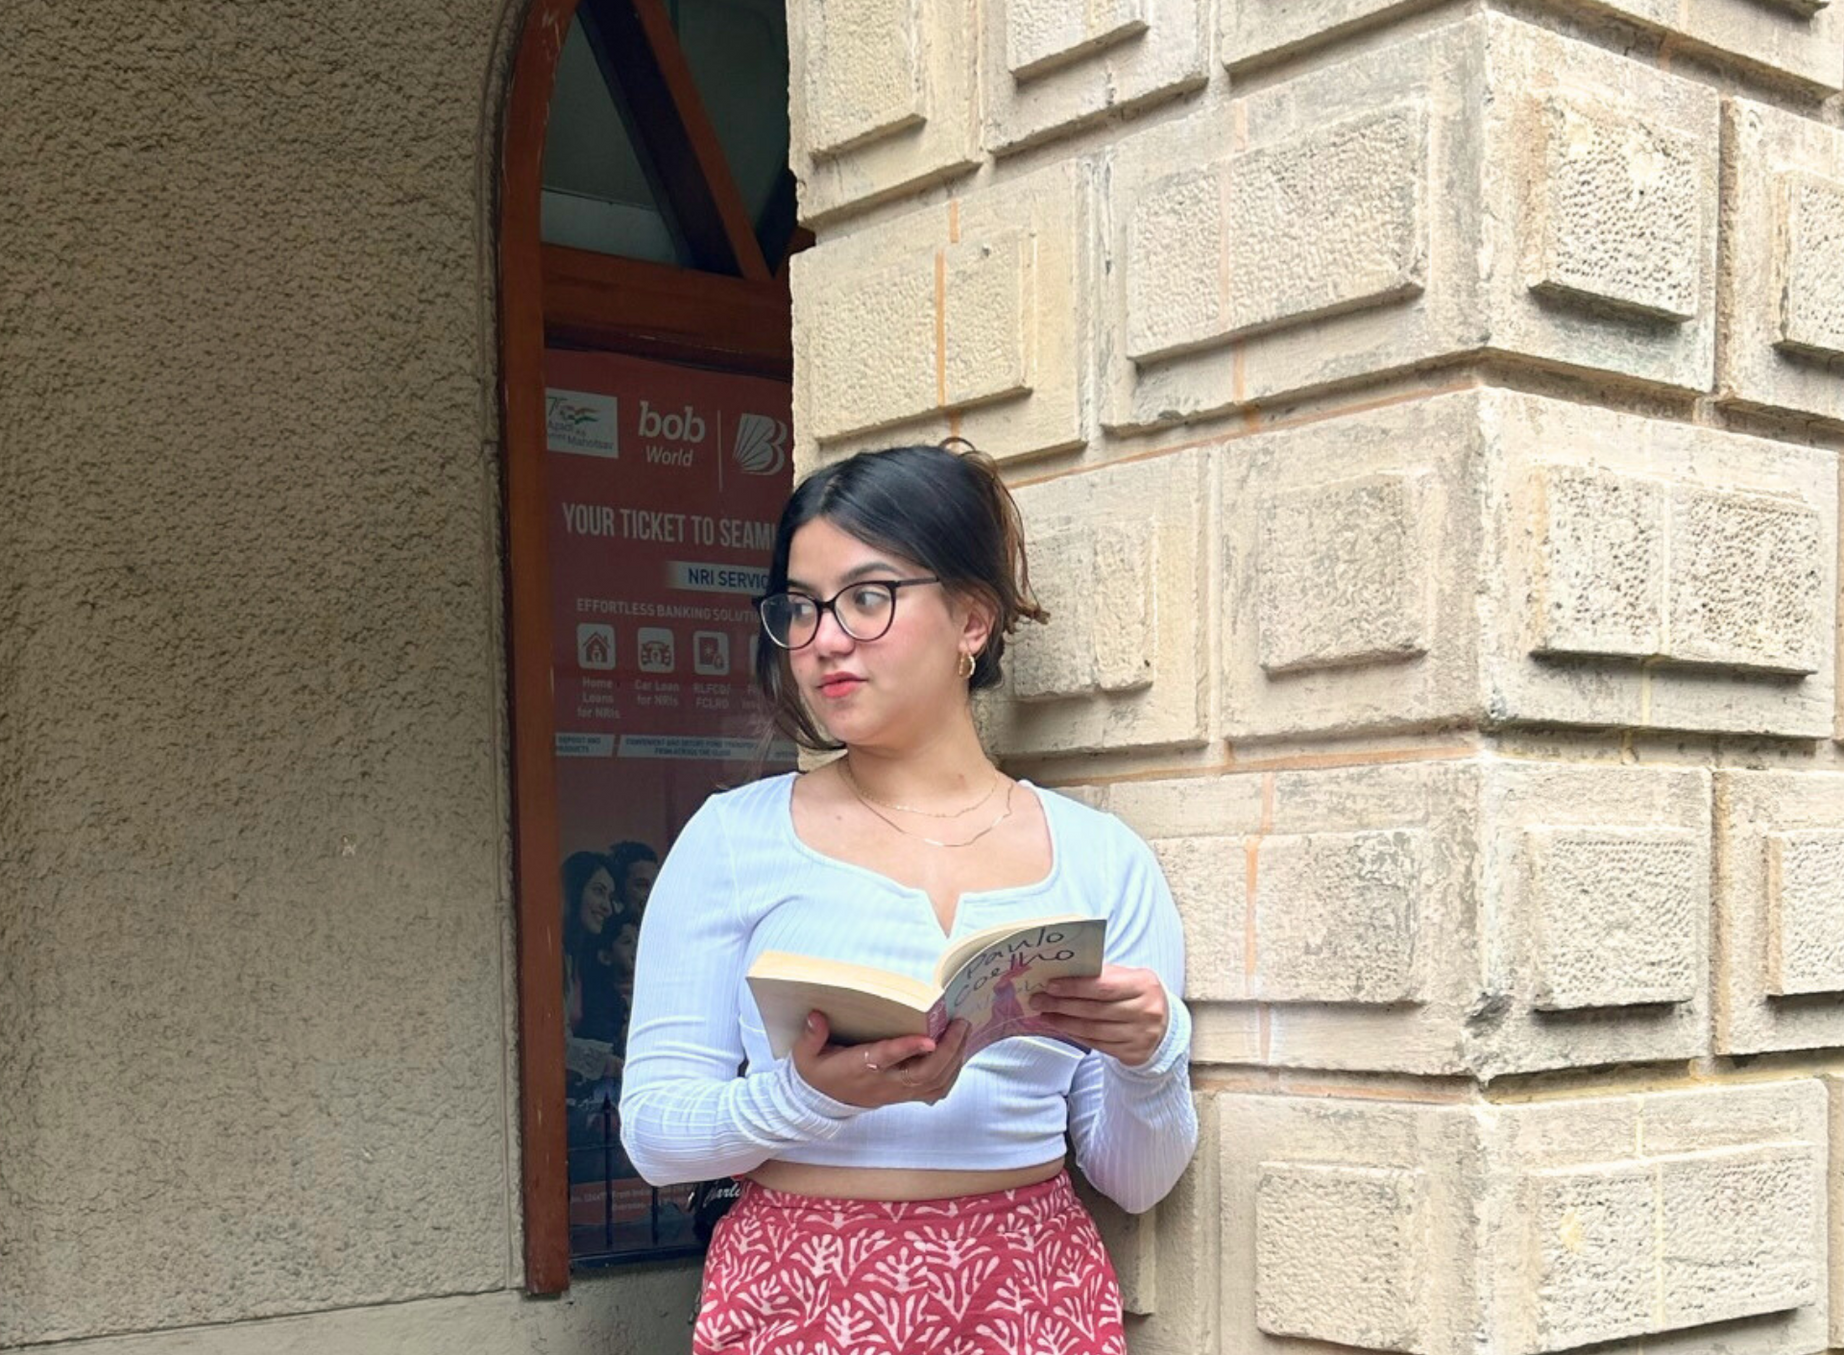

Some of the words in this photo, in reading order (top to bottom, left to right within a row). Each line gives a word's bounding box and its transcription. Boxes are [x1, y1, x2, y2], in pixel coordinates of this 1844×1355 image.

[638, 400, 706, 443] bob
[646, 445, 694, 467] World
[562, 502, 615, 537] YOUR
[620, 508, 686, 543] TICKET
[691, 515, 714, 546] TO
[688, 568, 714, 586] NRI
[577, 598, 656, 617] EFFORTLESS
[657, 604, 712, 620] BANKING
[582, 676, 613, 689] Home
[655, 679, 680, 691] Loan
[582, 691, 615, 704] Loans
[967, 927, 1064, 980] Paulo
[954, 949, 1075, 1007] Coelho
